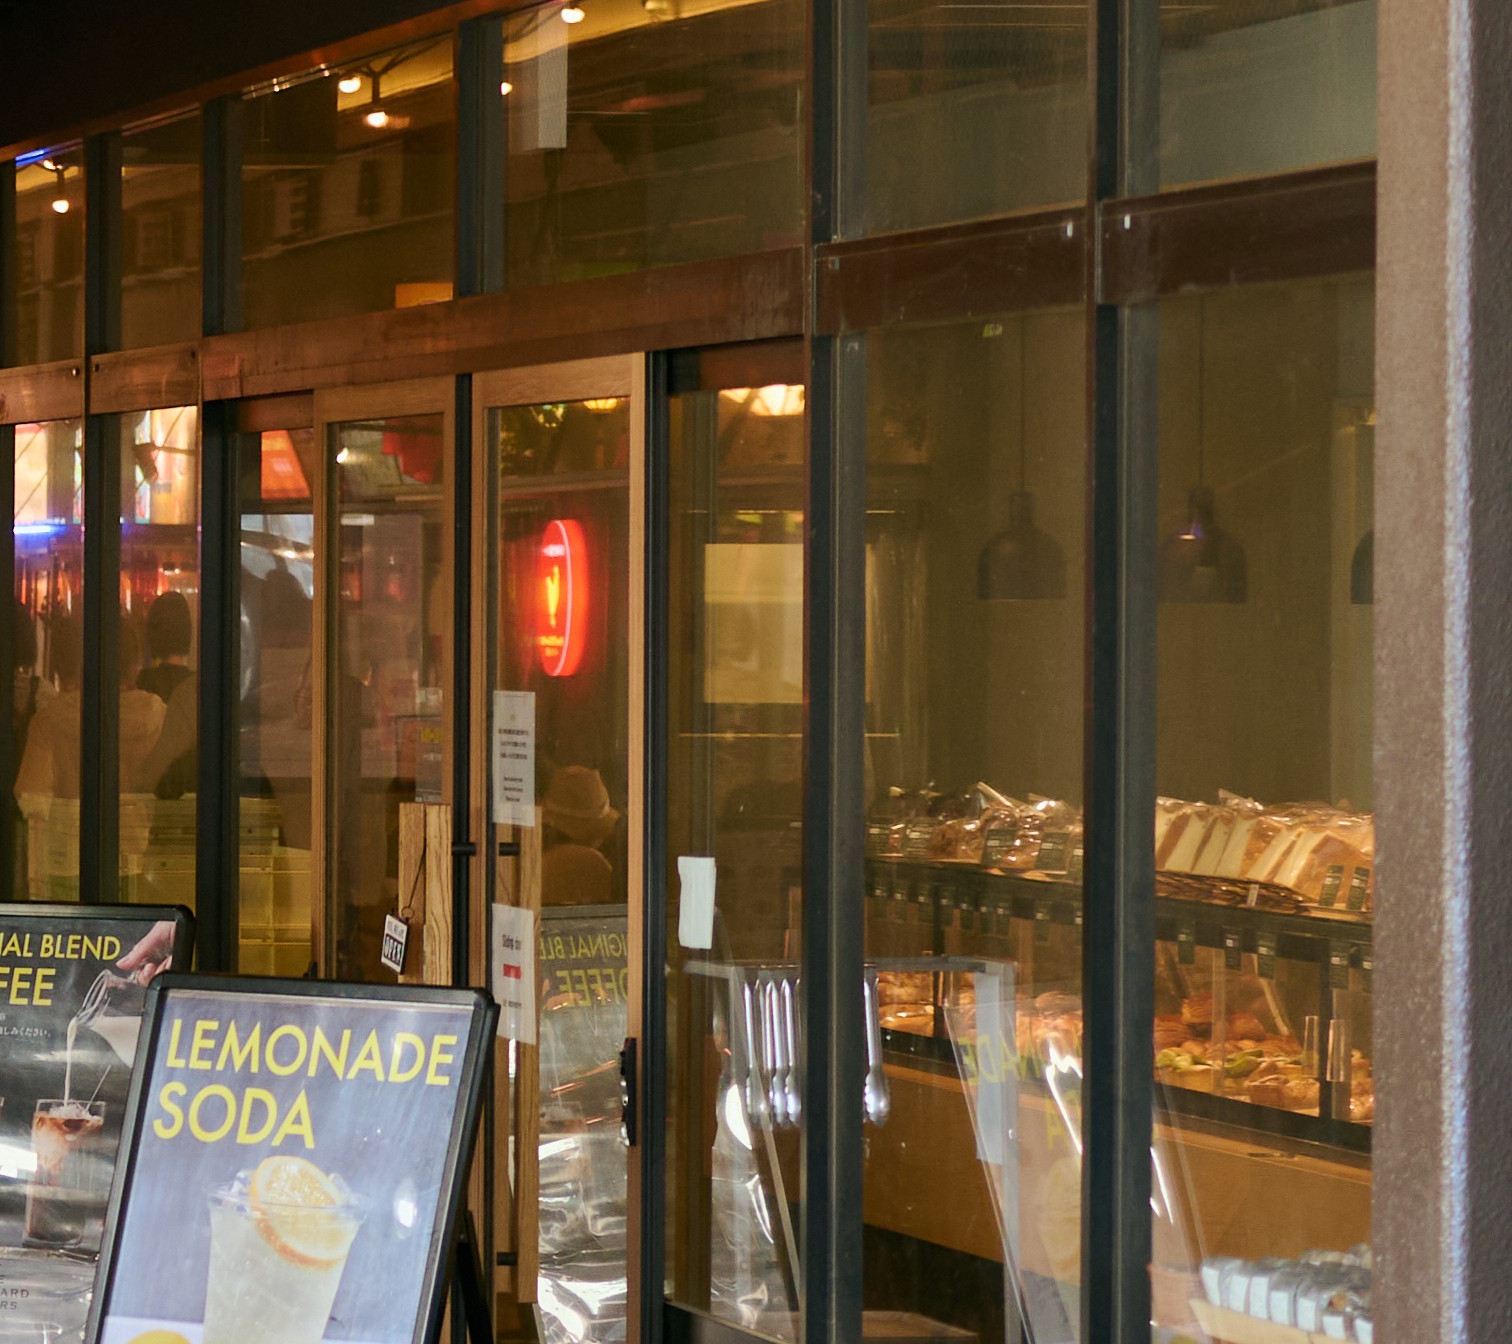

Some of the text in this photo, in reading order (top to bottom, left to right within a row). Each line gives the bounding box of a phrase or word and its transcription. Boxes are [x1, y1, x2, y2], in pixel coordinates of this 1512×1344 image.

[39, 934, 121, 961] BLEND
[166, 1019, 457, 1086] LEMONADE
[153, 1081, 315, 1149] SODA
